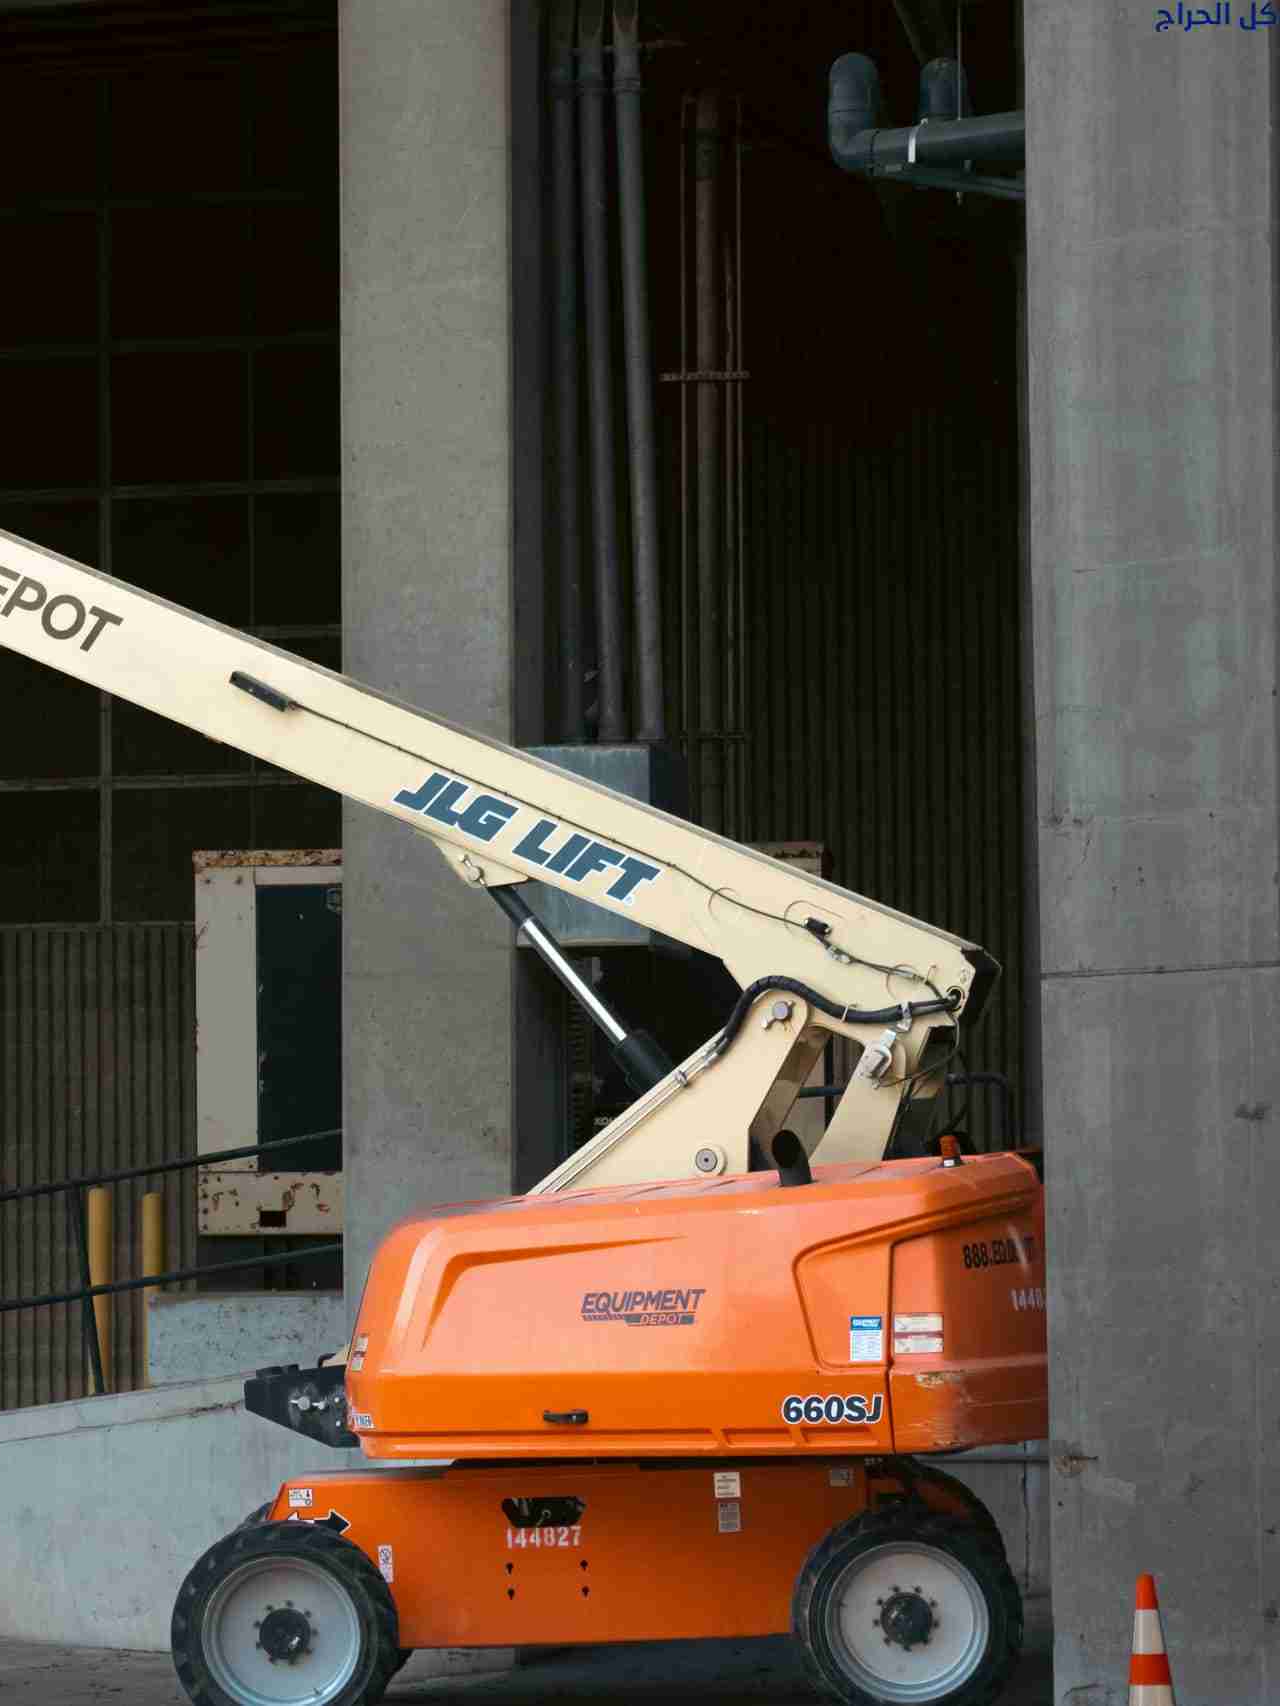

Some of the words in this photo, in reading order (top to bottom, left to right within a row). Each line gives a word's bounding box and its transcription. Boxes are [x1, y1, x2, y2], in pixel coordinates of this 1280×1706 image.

[392, 771, 520, 842] JLG
[511, 819, 661, 901] LIFT
[581, 1288, 706, 1313] EQUIPMENT
[640, 1311, 680, 1325] DEPOT
[782, 1394, 883, 1424] 660SJ
[506, 1526, 582, 1549] 144827
